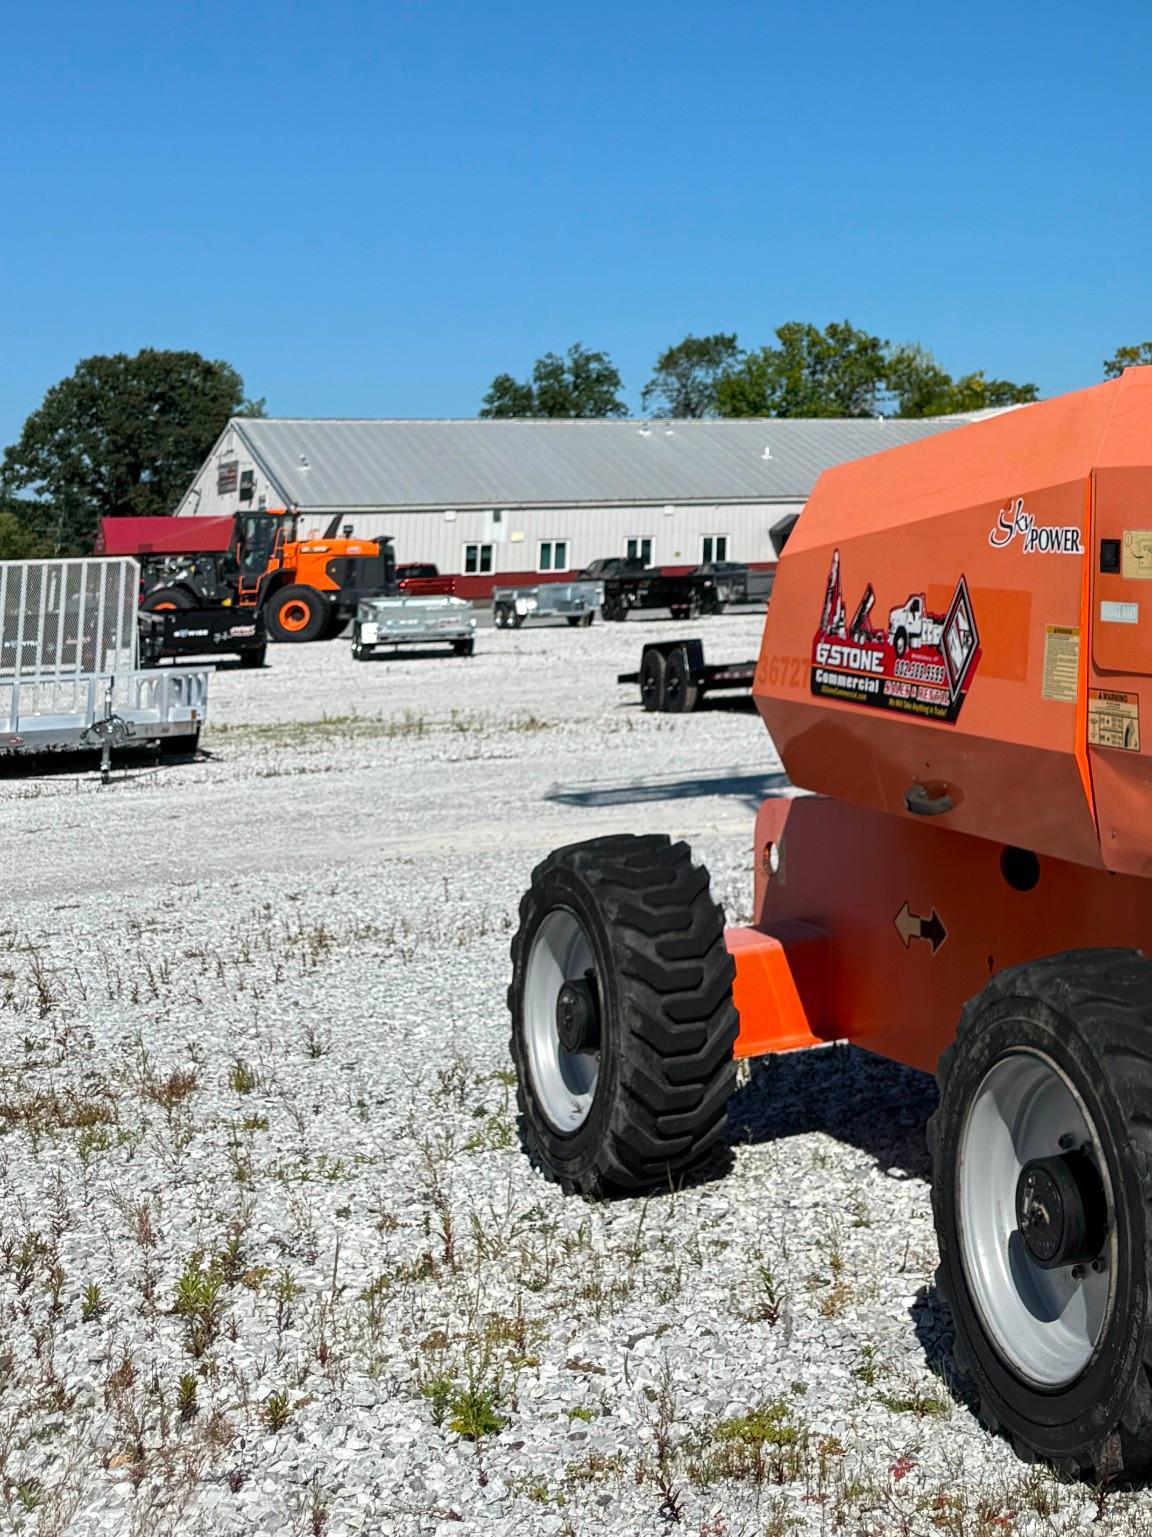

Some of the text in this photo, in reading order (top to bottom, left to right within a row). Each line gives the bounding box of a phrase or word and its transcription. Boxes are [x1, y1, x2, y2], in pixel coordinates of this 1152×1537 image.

[990, 499, 1081, 552] Sky POWER
[815, 669, 879, 694] Commercial
